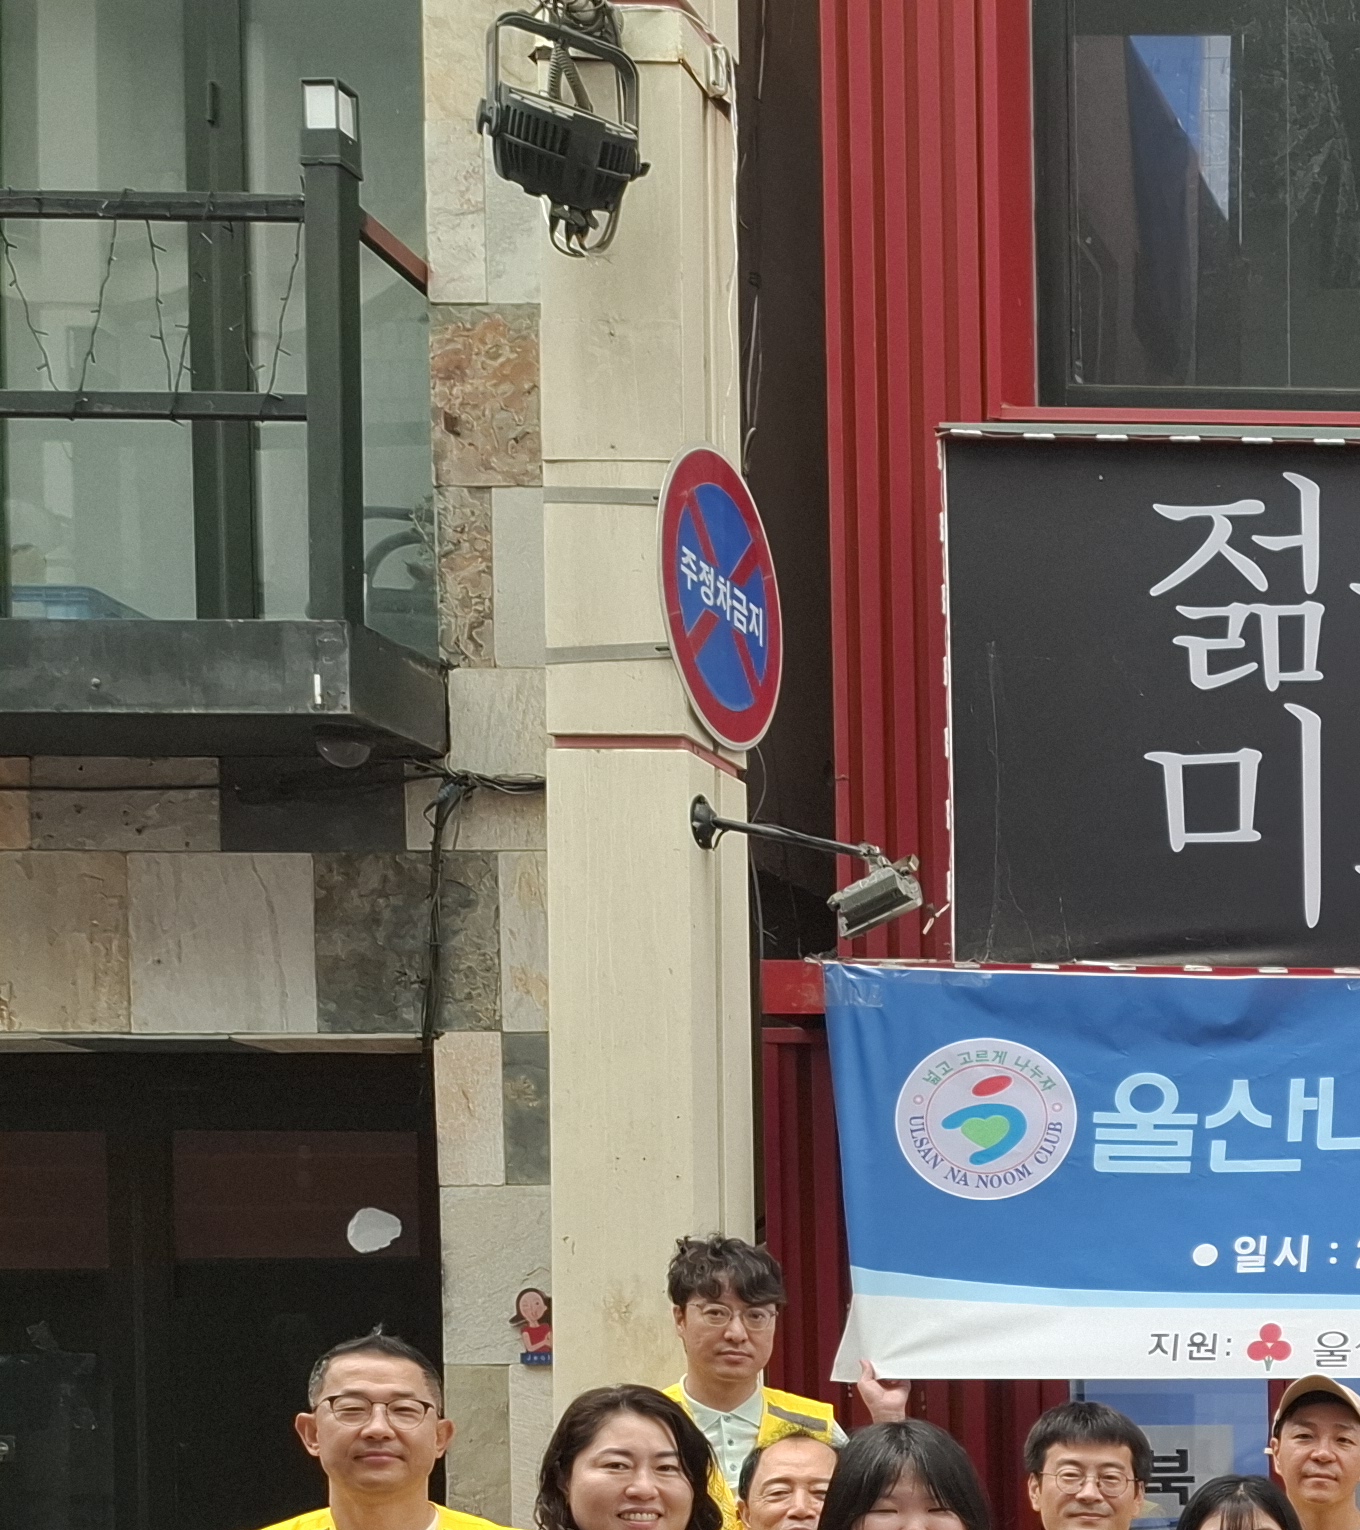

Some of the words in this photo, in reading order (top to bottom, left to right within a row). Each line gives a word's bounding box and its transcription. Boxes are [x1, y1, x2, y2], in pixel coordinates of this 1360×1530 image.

[680, 545, 763, 647] 주정차금지
[957, 1050, 1008, 1065] 고르게
[1014, 1056, 1057, 1092] 나누자
[909, 1115, 944, 1169] ULSAN
[943, 1167, 969, 1187] NA
[975, 1164, 1033, 1189] NOOM
[1034, 1121, 1063, 1165] CLUB
[1233, 1233, 1310, 1273] 일시
[1148, 1331, 1232, 1362] 지원:
